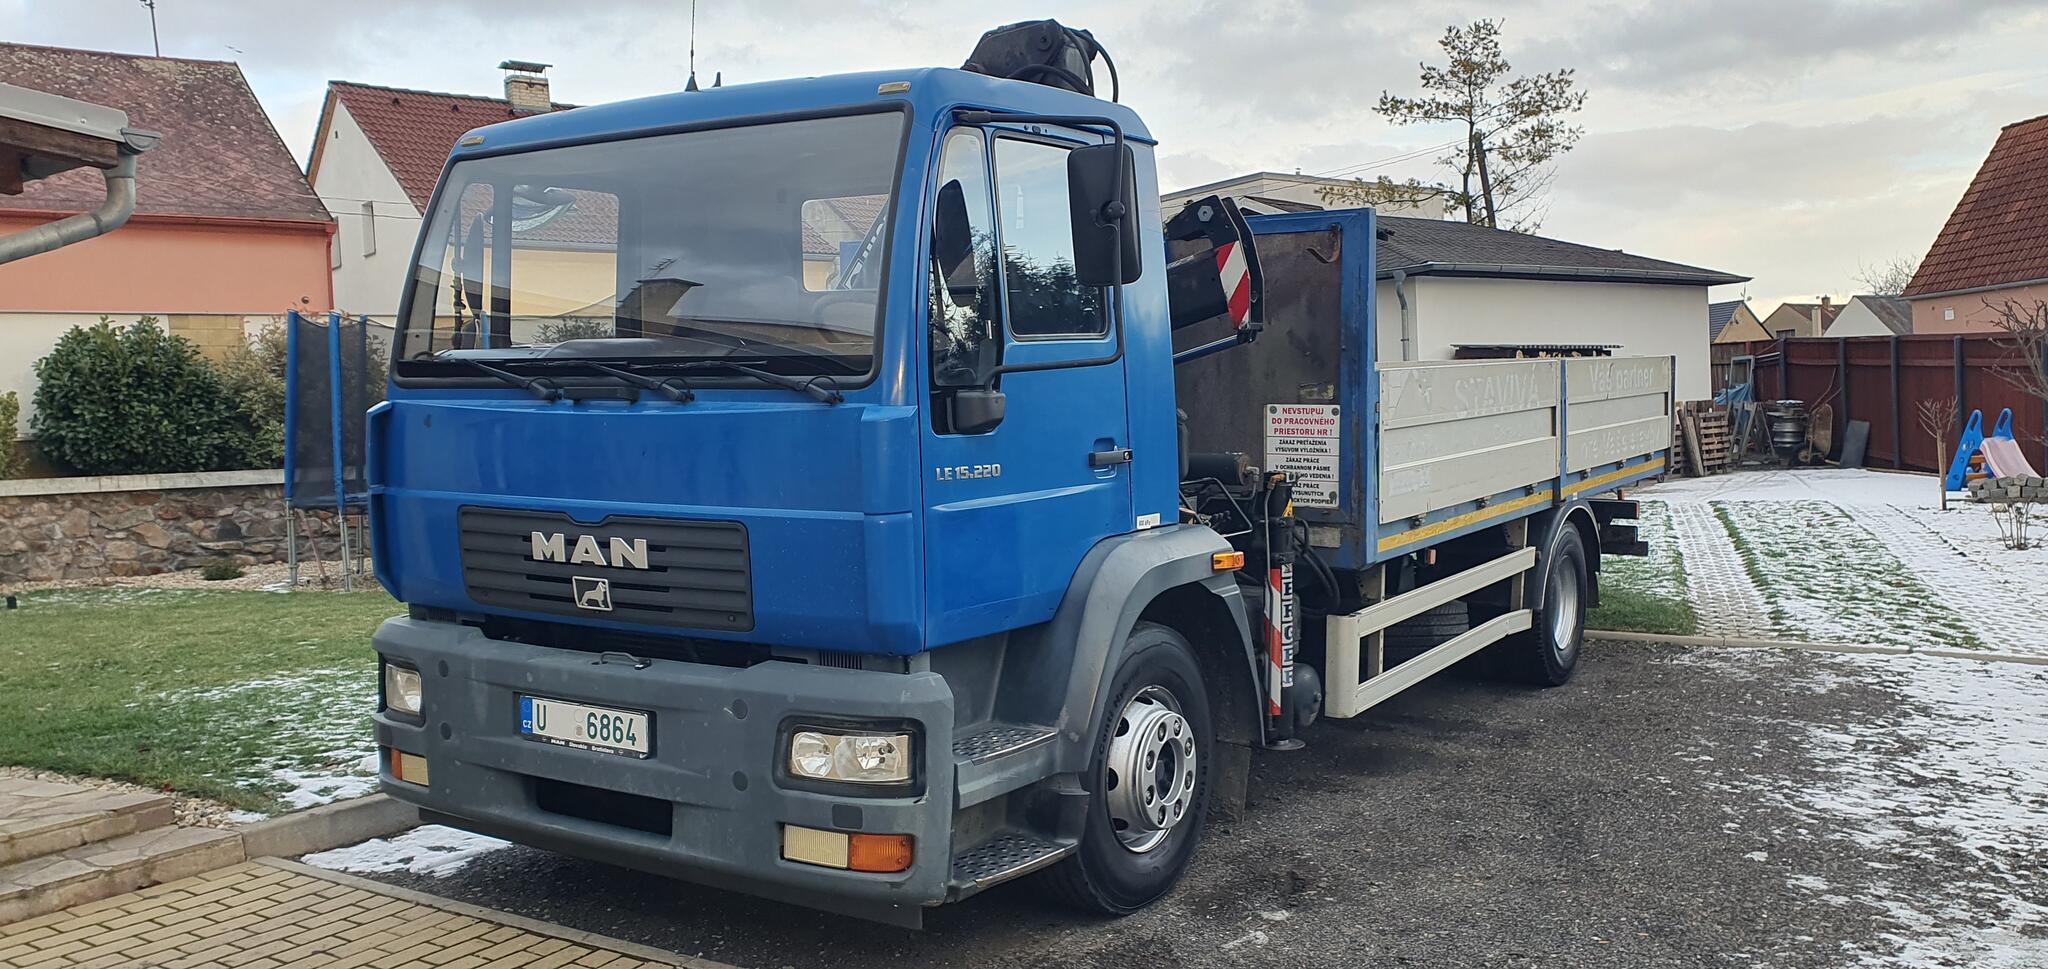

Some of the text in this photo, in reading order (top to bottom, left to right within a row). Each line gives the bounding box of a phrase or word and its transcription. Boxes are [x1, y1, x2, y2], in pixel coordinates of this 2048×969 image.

[1282, 407, 1324, 415] NEVSTUPUJ
[1271, 416, 1335, 426] DO PRACOVNÉHO
[1274, 427, 1316, 435] PRIESTORU
[1317, 428, 1328, 436] HR
[936, 464, 1001, 481] LE 15.220
[531, 531, 649, 569] MAN
[522, 719, 532, 729] CZ
[536, 703, 637, 746] U 6864
